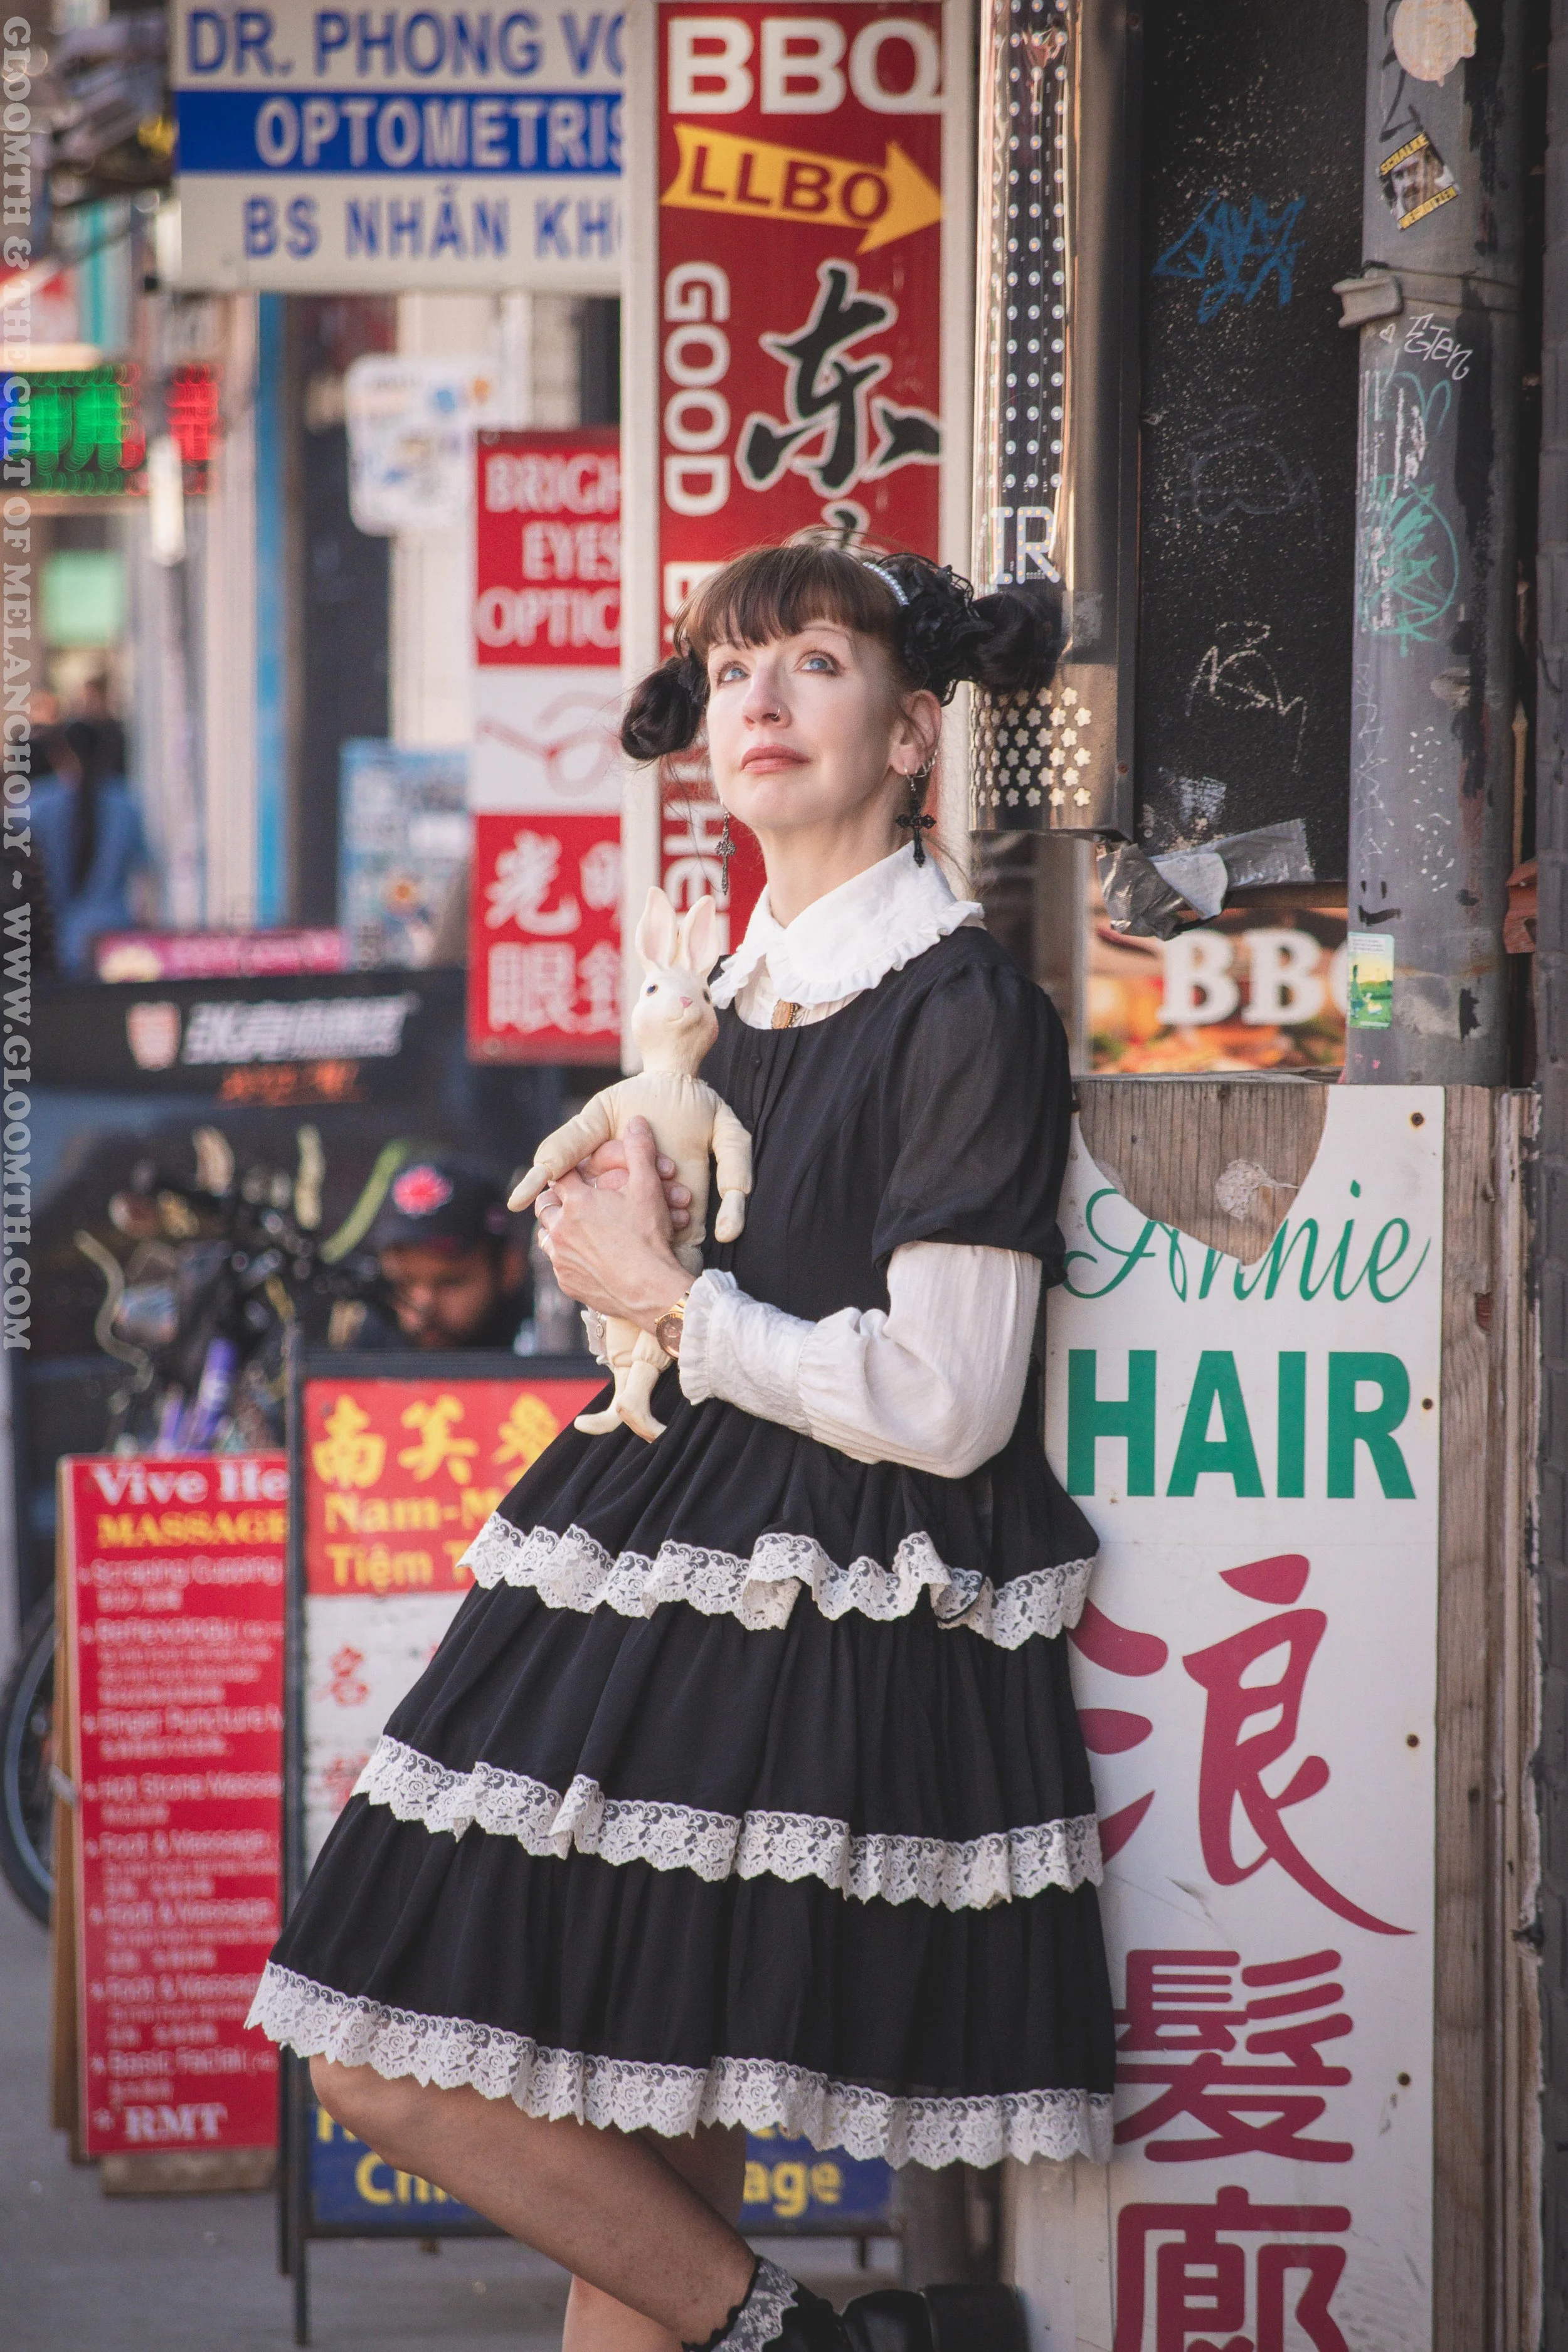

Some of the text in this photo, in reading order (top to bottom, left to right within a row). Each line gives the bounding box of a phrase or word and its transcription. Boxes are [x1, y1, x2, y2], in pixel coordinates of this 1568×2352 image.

[188, 11, 295, 77] DR.
[316, 11, 544, 78] PHONG
[667, 18, 941, 115] BBQ
[687, 145, 889, 225] LLBO
[243, 196, 320, 260] BS
[664, 262, 731, 516] GOOD
[1066, 1349, 1416, 1500] HAIR
[91, 1462, 209, 1505] Vive
[126, 2104, 226, 2141] RMT
